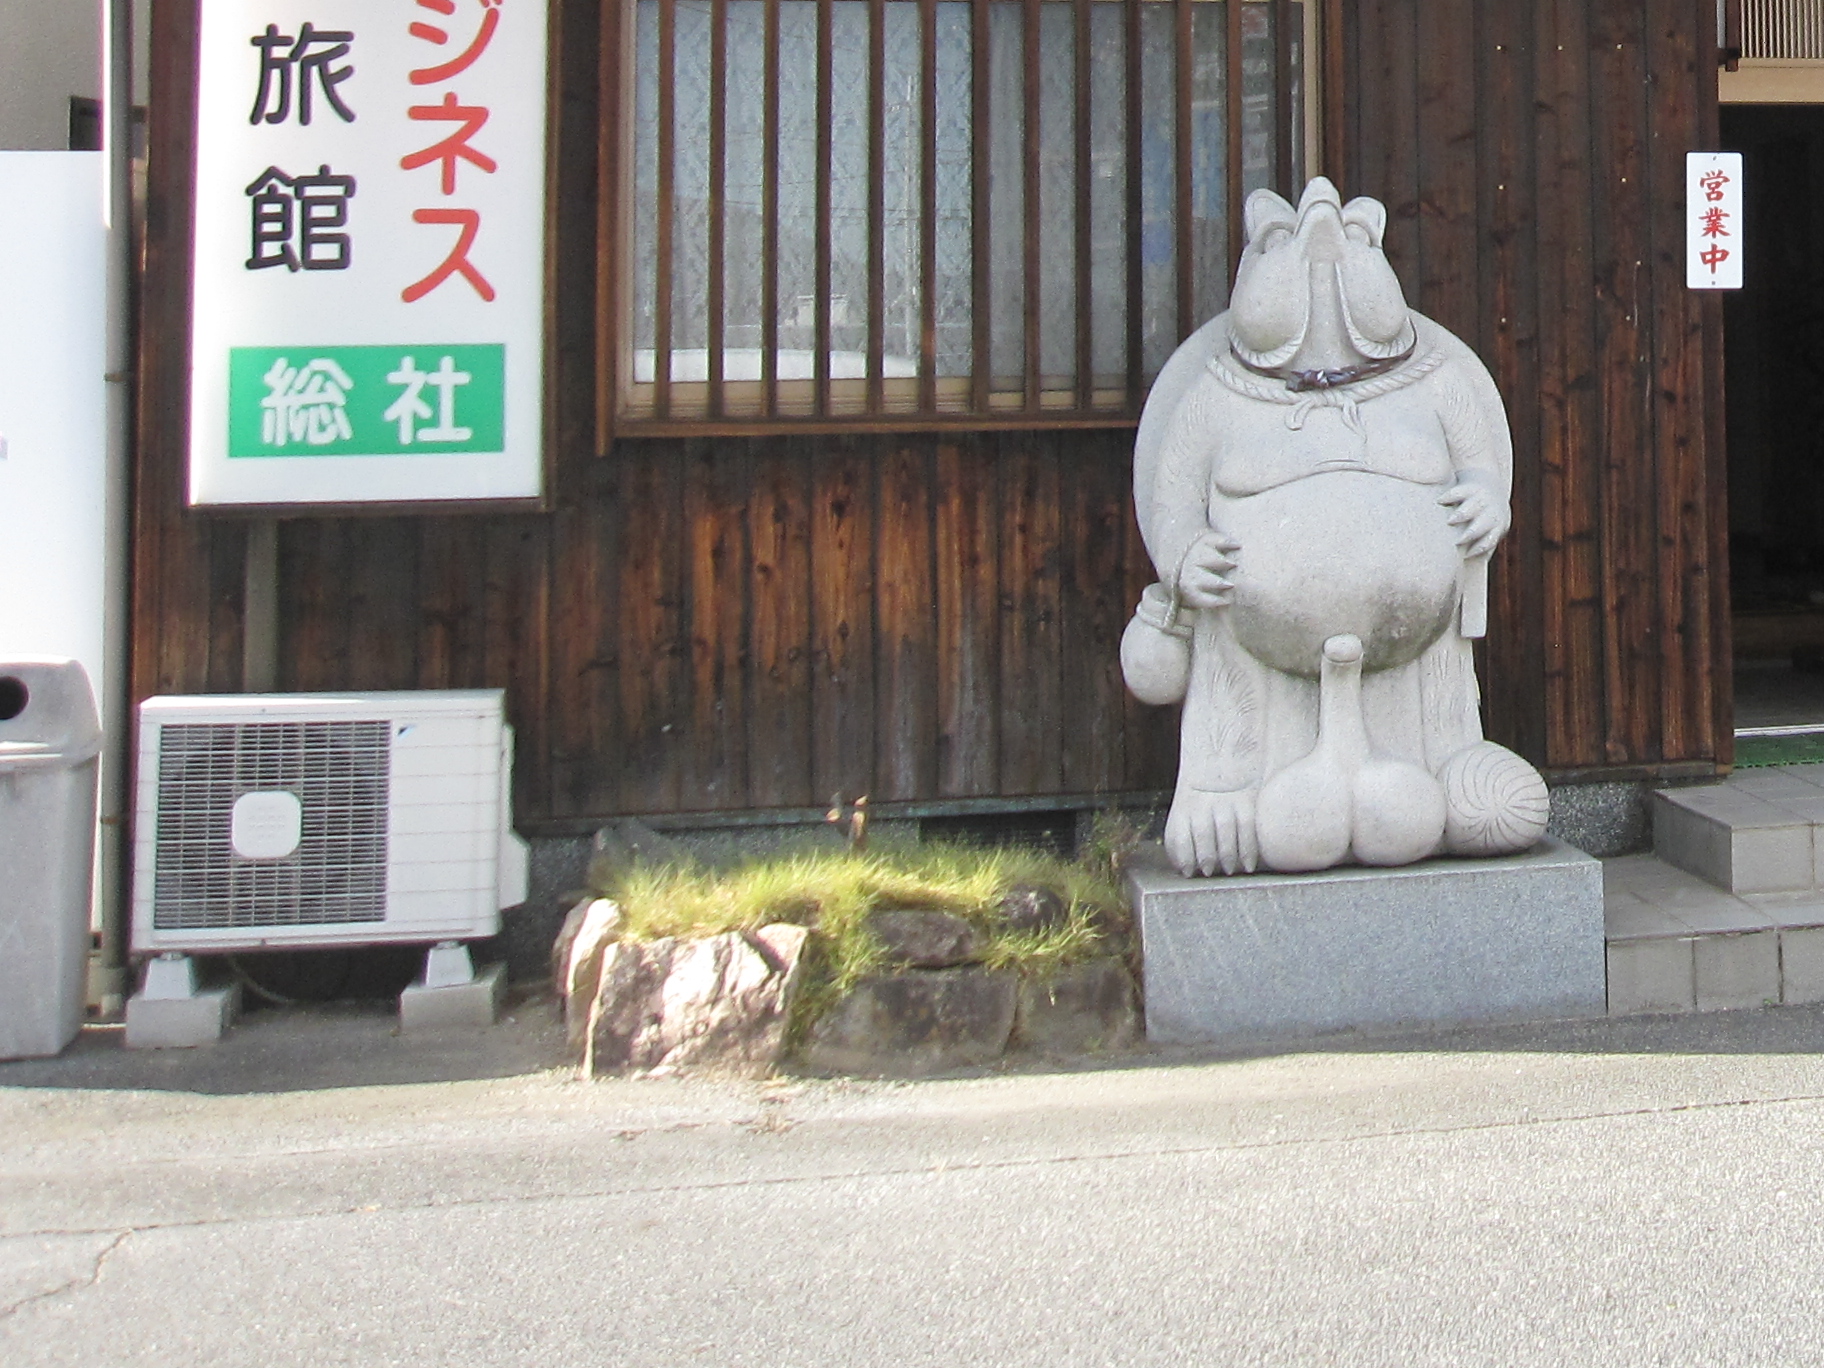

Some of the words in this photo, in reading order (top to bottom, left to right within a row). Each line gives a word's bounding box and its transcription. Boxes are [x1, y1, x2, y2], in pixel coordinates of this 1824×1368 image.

[245, 22, 357, 274] 旅館
[1698, 169, 1731, 274] 営業中
[260, 355, 473, 446] 総社
